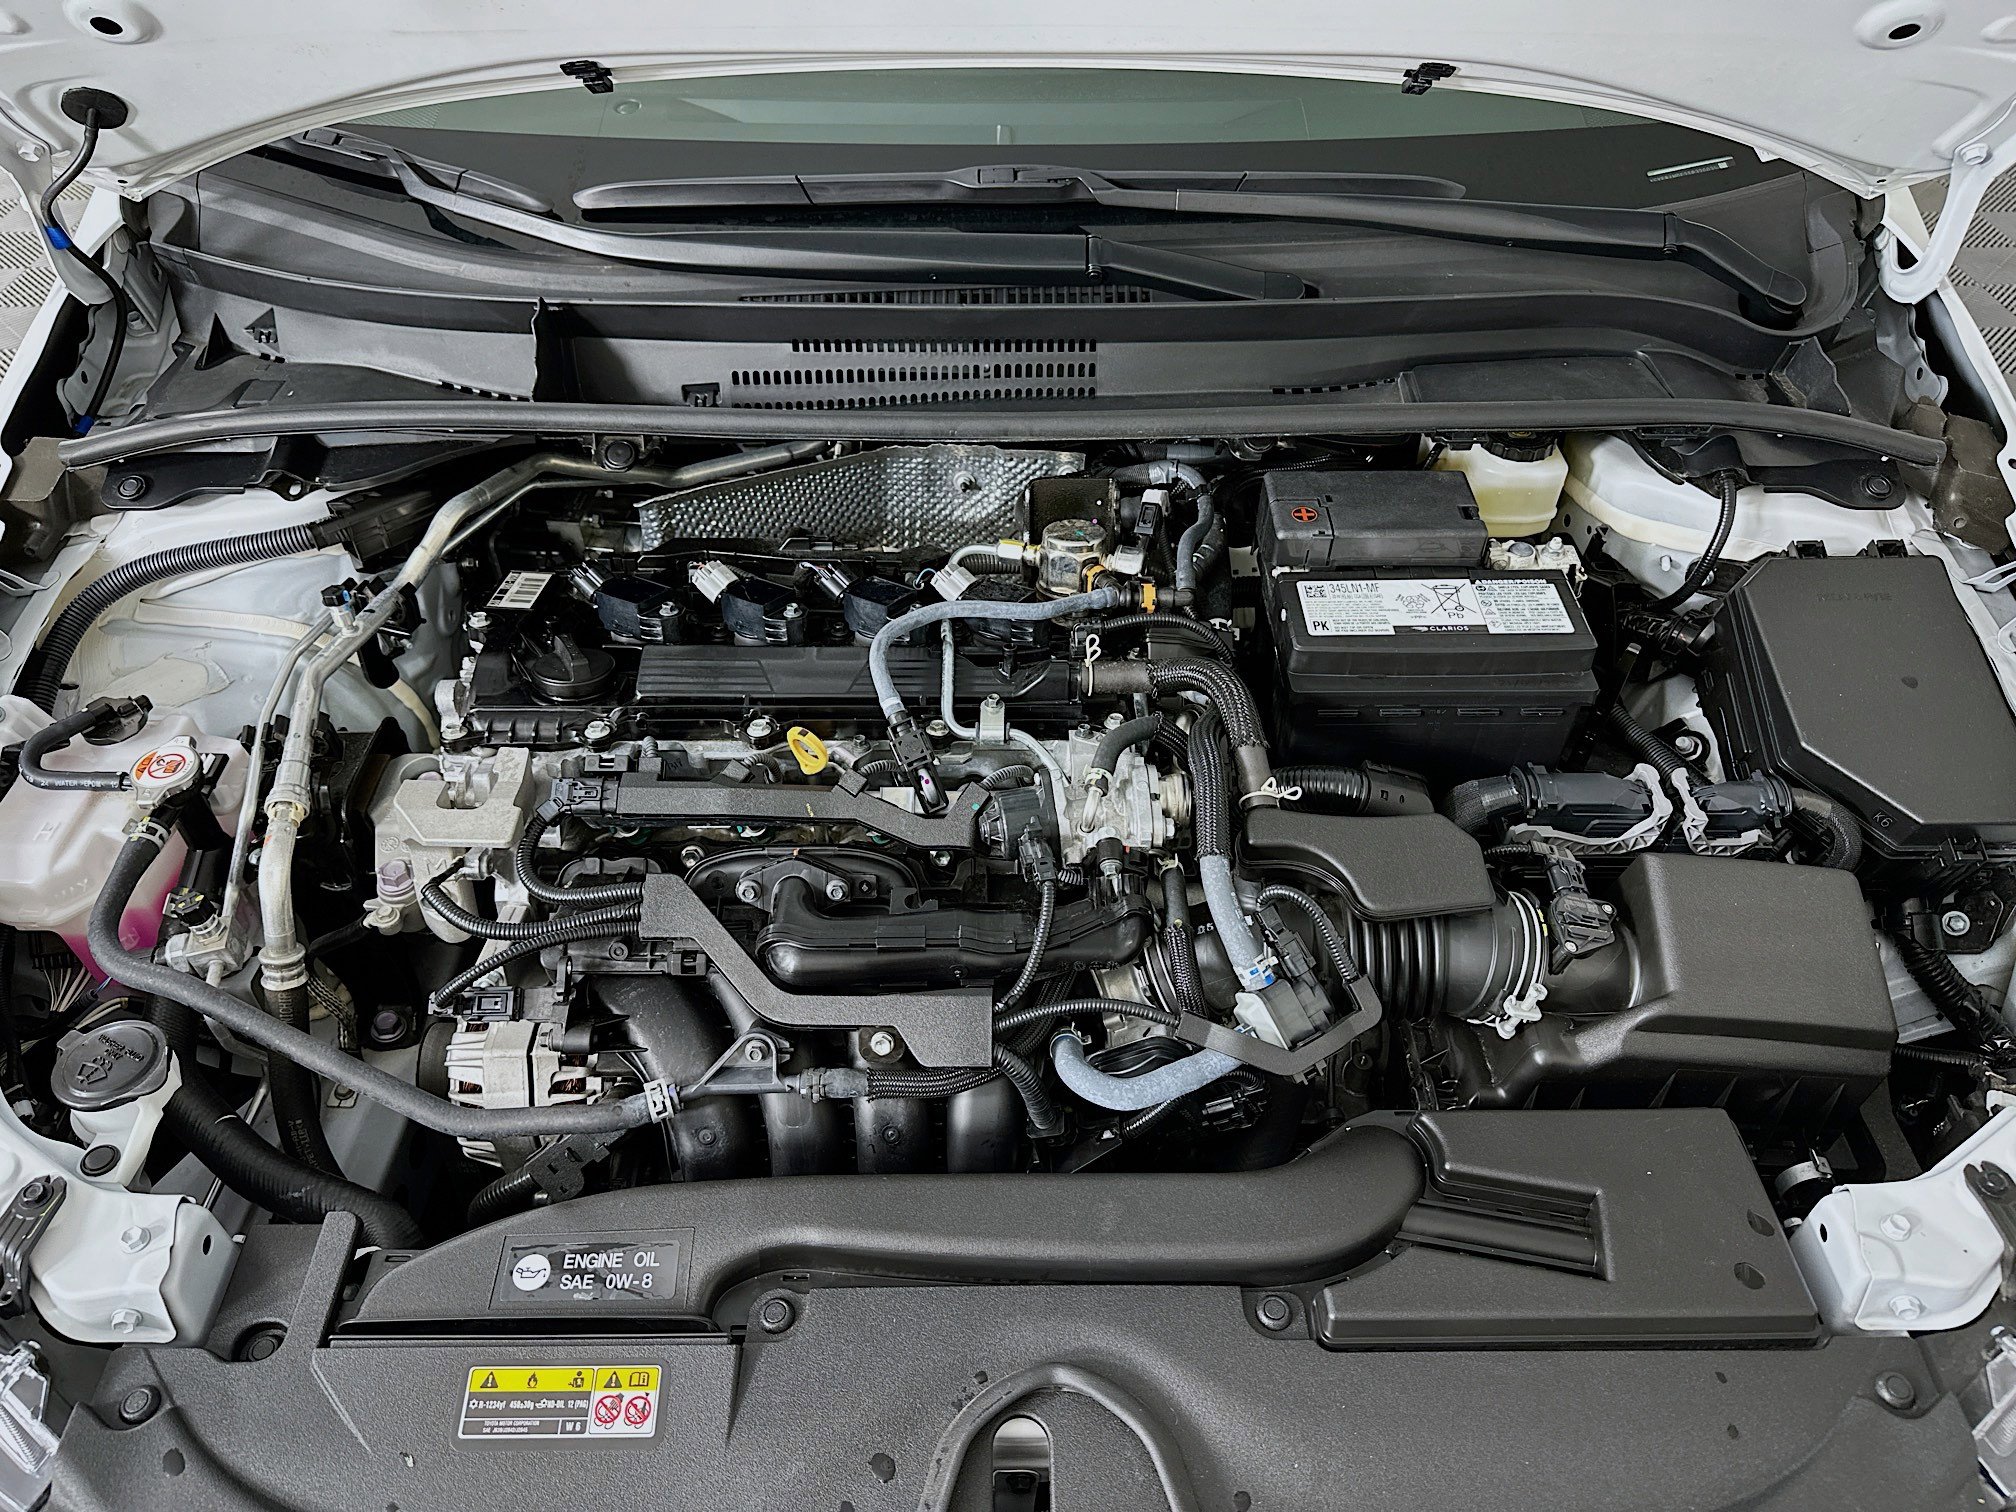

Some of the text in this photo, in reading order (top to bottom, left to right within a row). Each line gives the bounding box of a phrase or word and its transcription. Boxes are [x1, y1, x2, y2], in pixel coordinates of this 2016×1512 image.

[1329, 583, 1380, 593] 345LN1-MF
[1447, 611, 1465, 619] Pb
[1312, 620, 1330, 631] PK
[1872, 811, 1893, 828] K6
[563, 1251, 660, 1269] ENGINE OIL
[559, 1273, 653, 1290] SAE 0W-8
